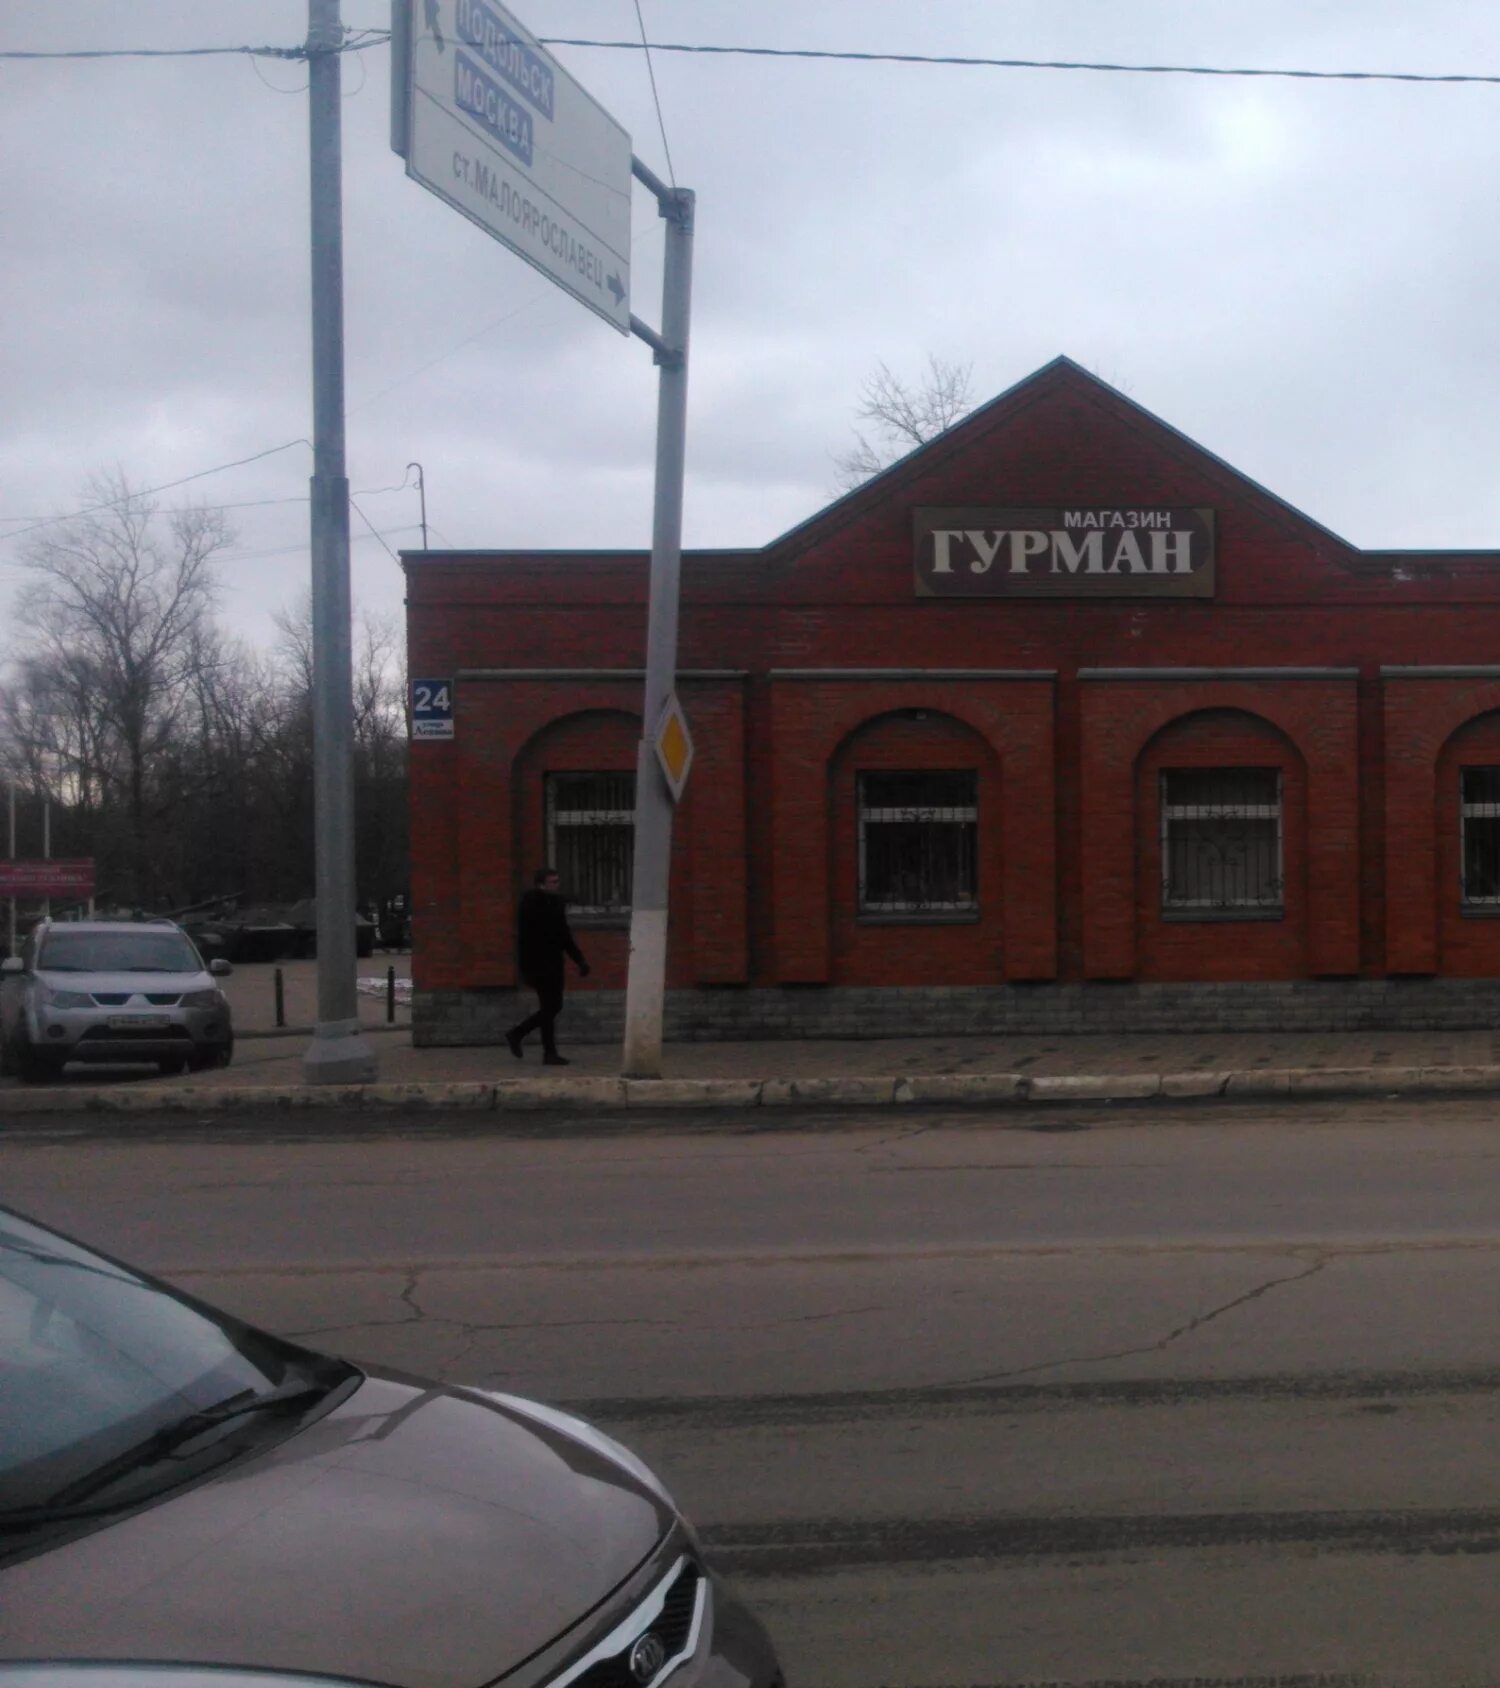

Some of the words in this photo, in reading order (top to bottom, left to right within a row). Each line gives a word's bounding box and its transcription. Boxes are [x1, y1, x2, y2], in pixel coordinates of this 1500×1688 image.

[458, 62, 531, 149] МОСКВА
[1064, 511, 1171, 529] МАГАЗИН
[931, 530, 1194, 573] ГУРМАН
[415, 686, 450, 711] 24
